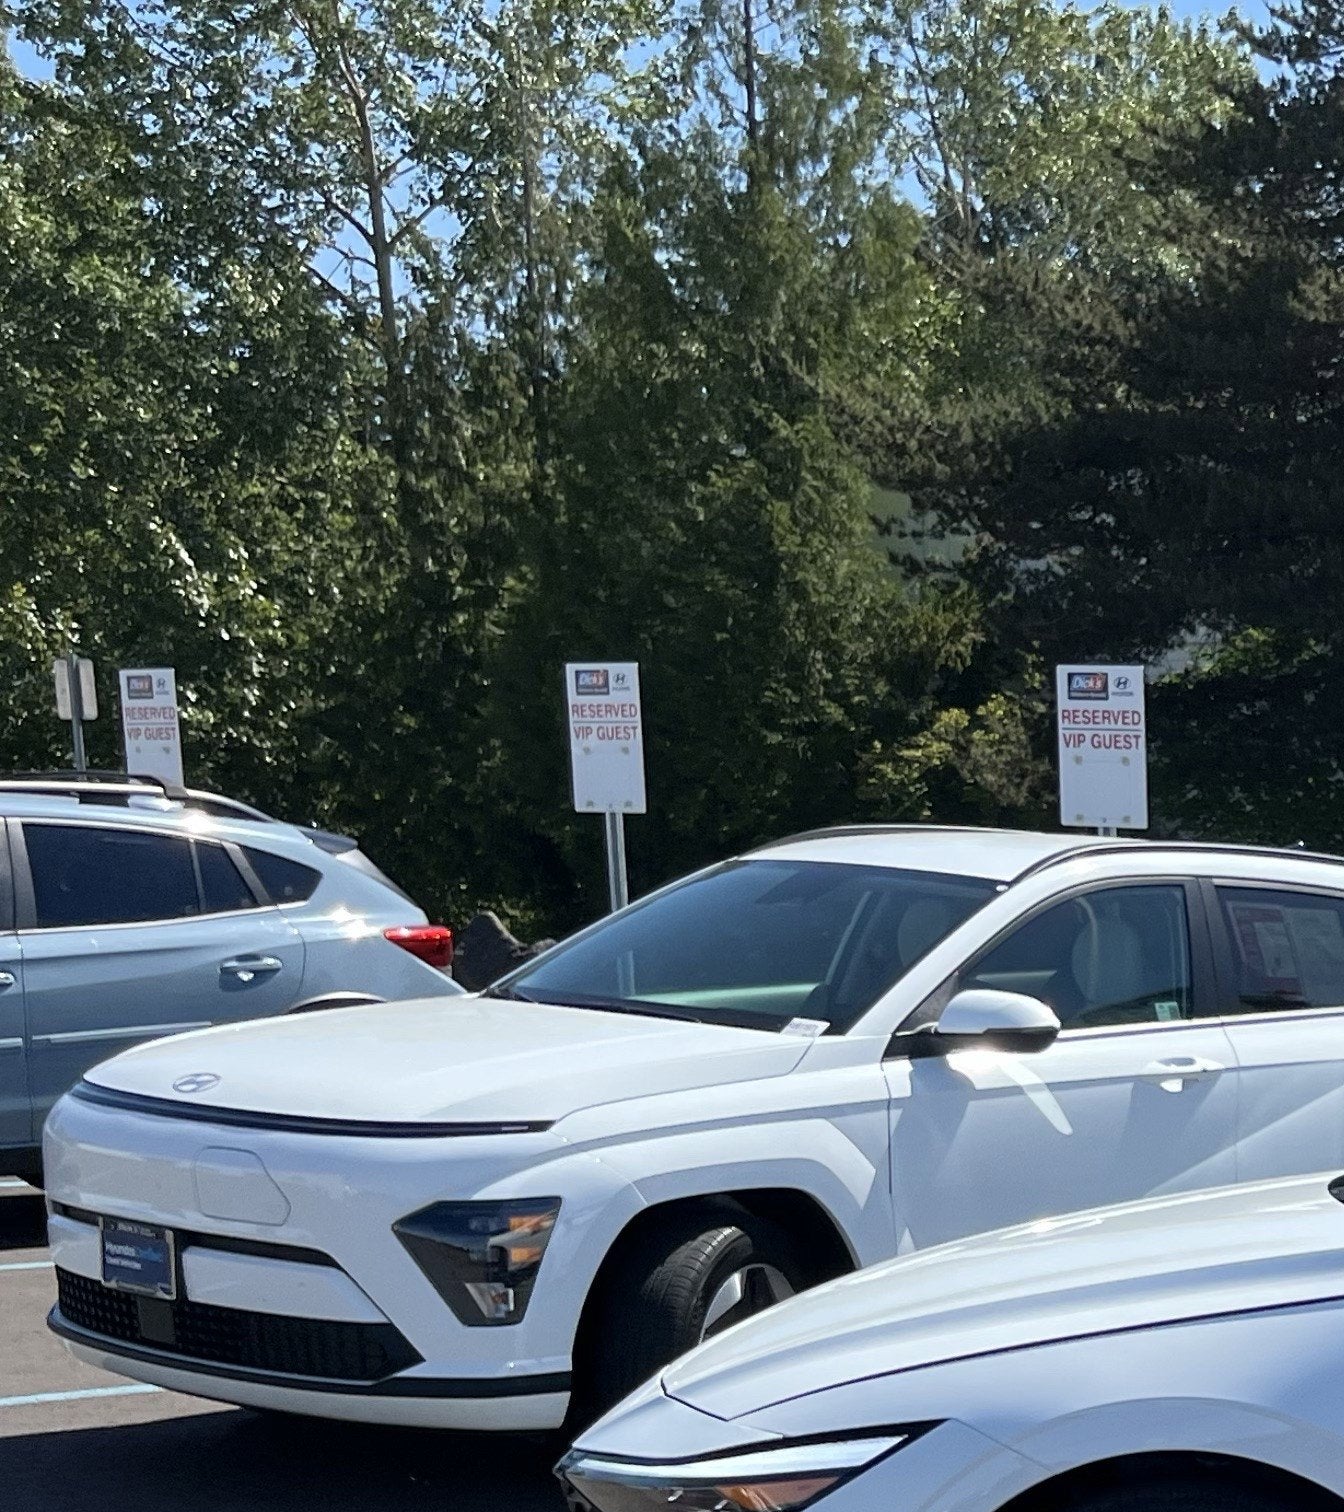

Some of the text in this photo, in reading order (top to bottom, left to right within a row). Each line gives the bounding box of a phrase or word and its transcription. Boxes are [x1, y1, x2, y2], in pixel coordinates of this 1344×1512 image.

[125, 706, 176, 720] RESERVED
[571, 703, 638, 718] RESERVED
[1062, 709, 1141, 726] RESERVED
[127, 727, 176, 740] VIP GUEST
[573, 725, 638, 741] VIP GUEST
[1062, 733, 1141, 750] VIP GUEST
